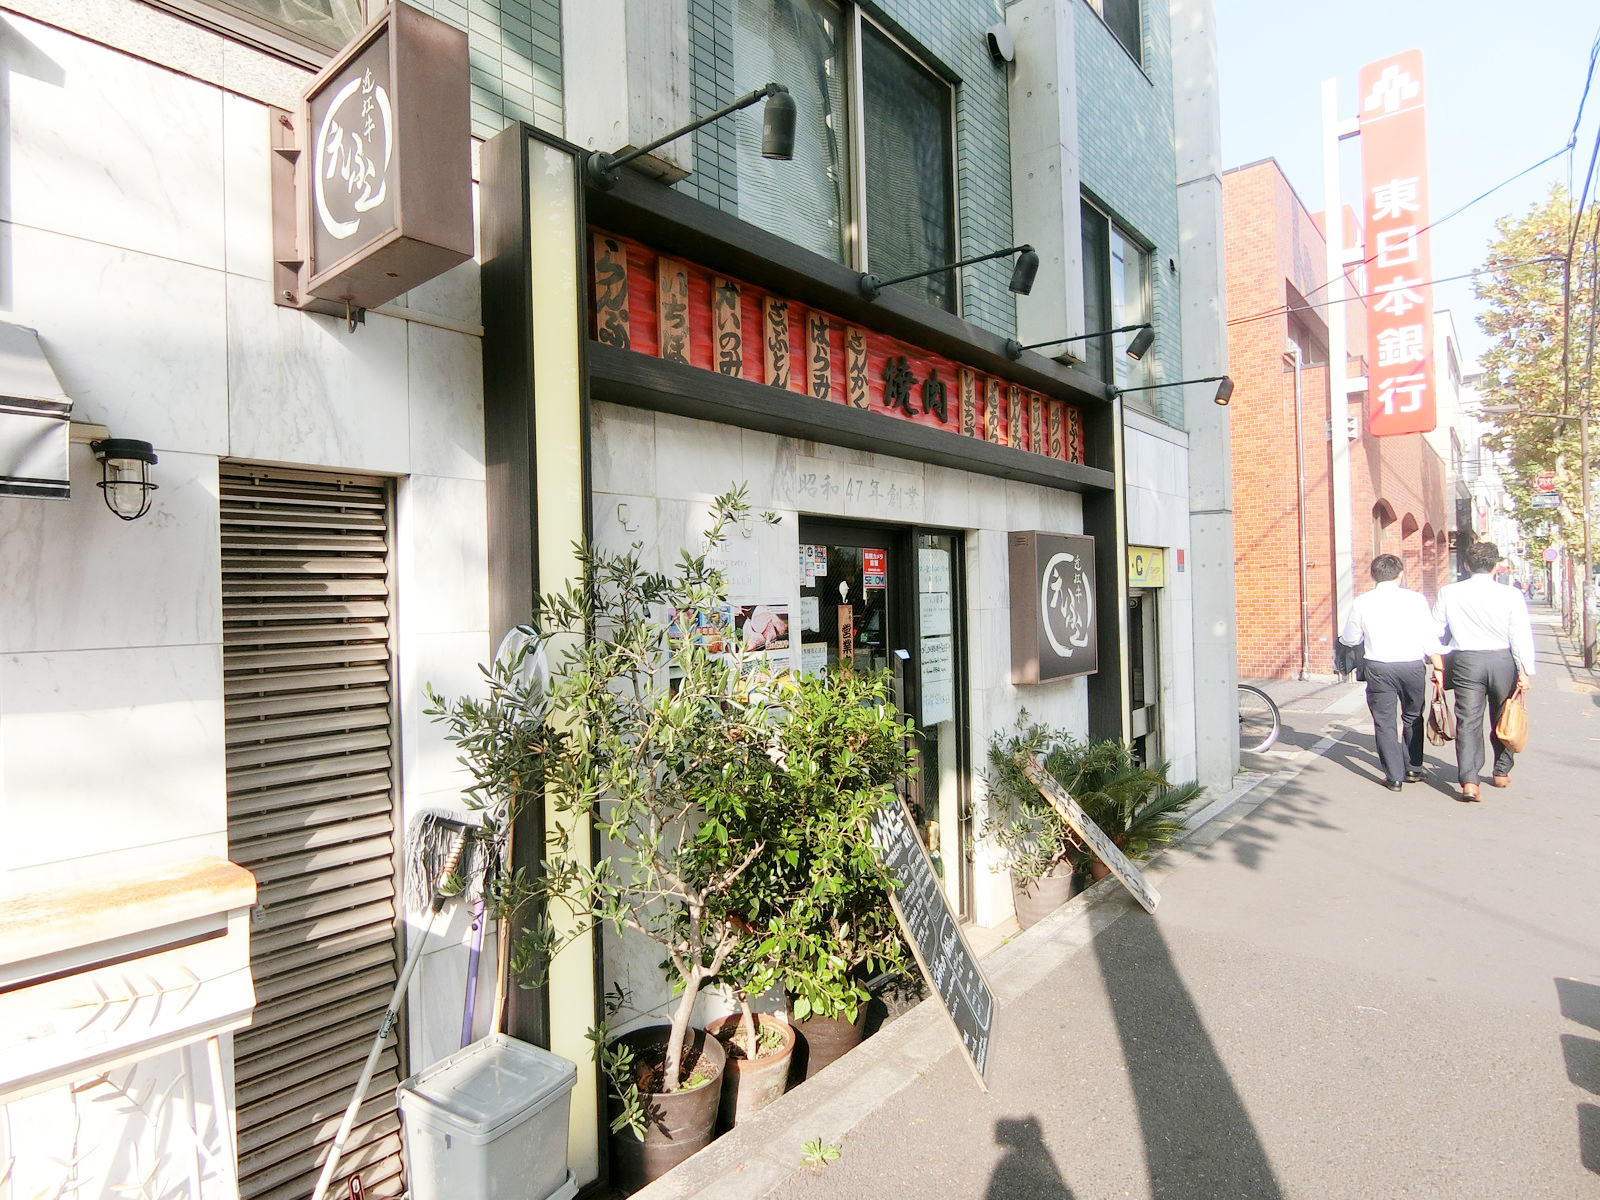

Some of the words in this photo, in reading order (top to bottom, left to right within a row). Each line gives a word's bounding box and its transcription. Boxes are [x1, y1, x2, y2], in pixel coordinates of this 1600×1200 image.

[361, 67, 376, 143] 近江牛
[716, 280, 743, 378] かいのみ
[1371, 177, 1427, 416] 東日本銀行
[768, 301, 790, 390] ざぶとん
[810, 315, 831, 401] はらみ
[849, 330, 869, 410] さんかく
[882, 356, 948, 424] 焼肉
[1051, 407, 1061, 459] みの
[799, 473, 920, 512] 昭和47年創業
[1074, 555, 1083, 604] 近江牛
